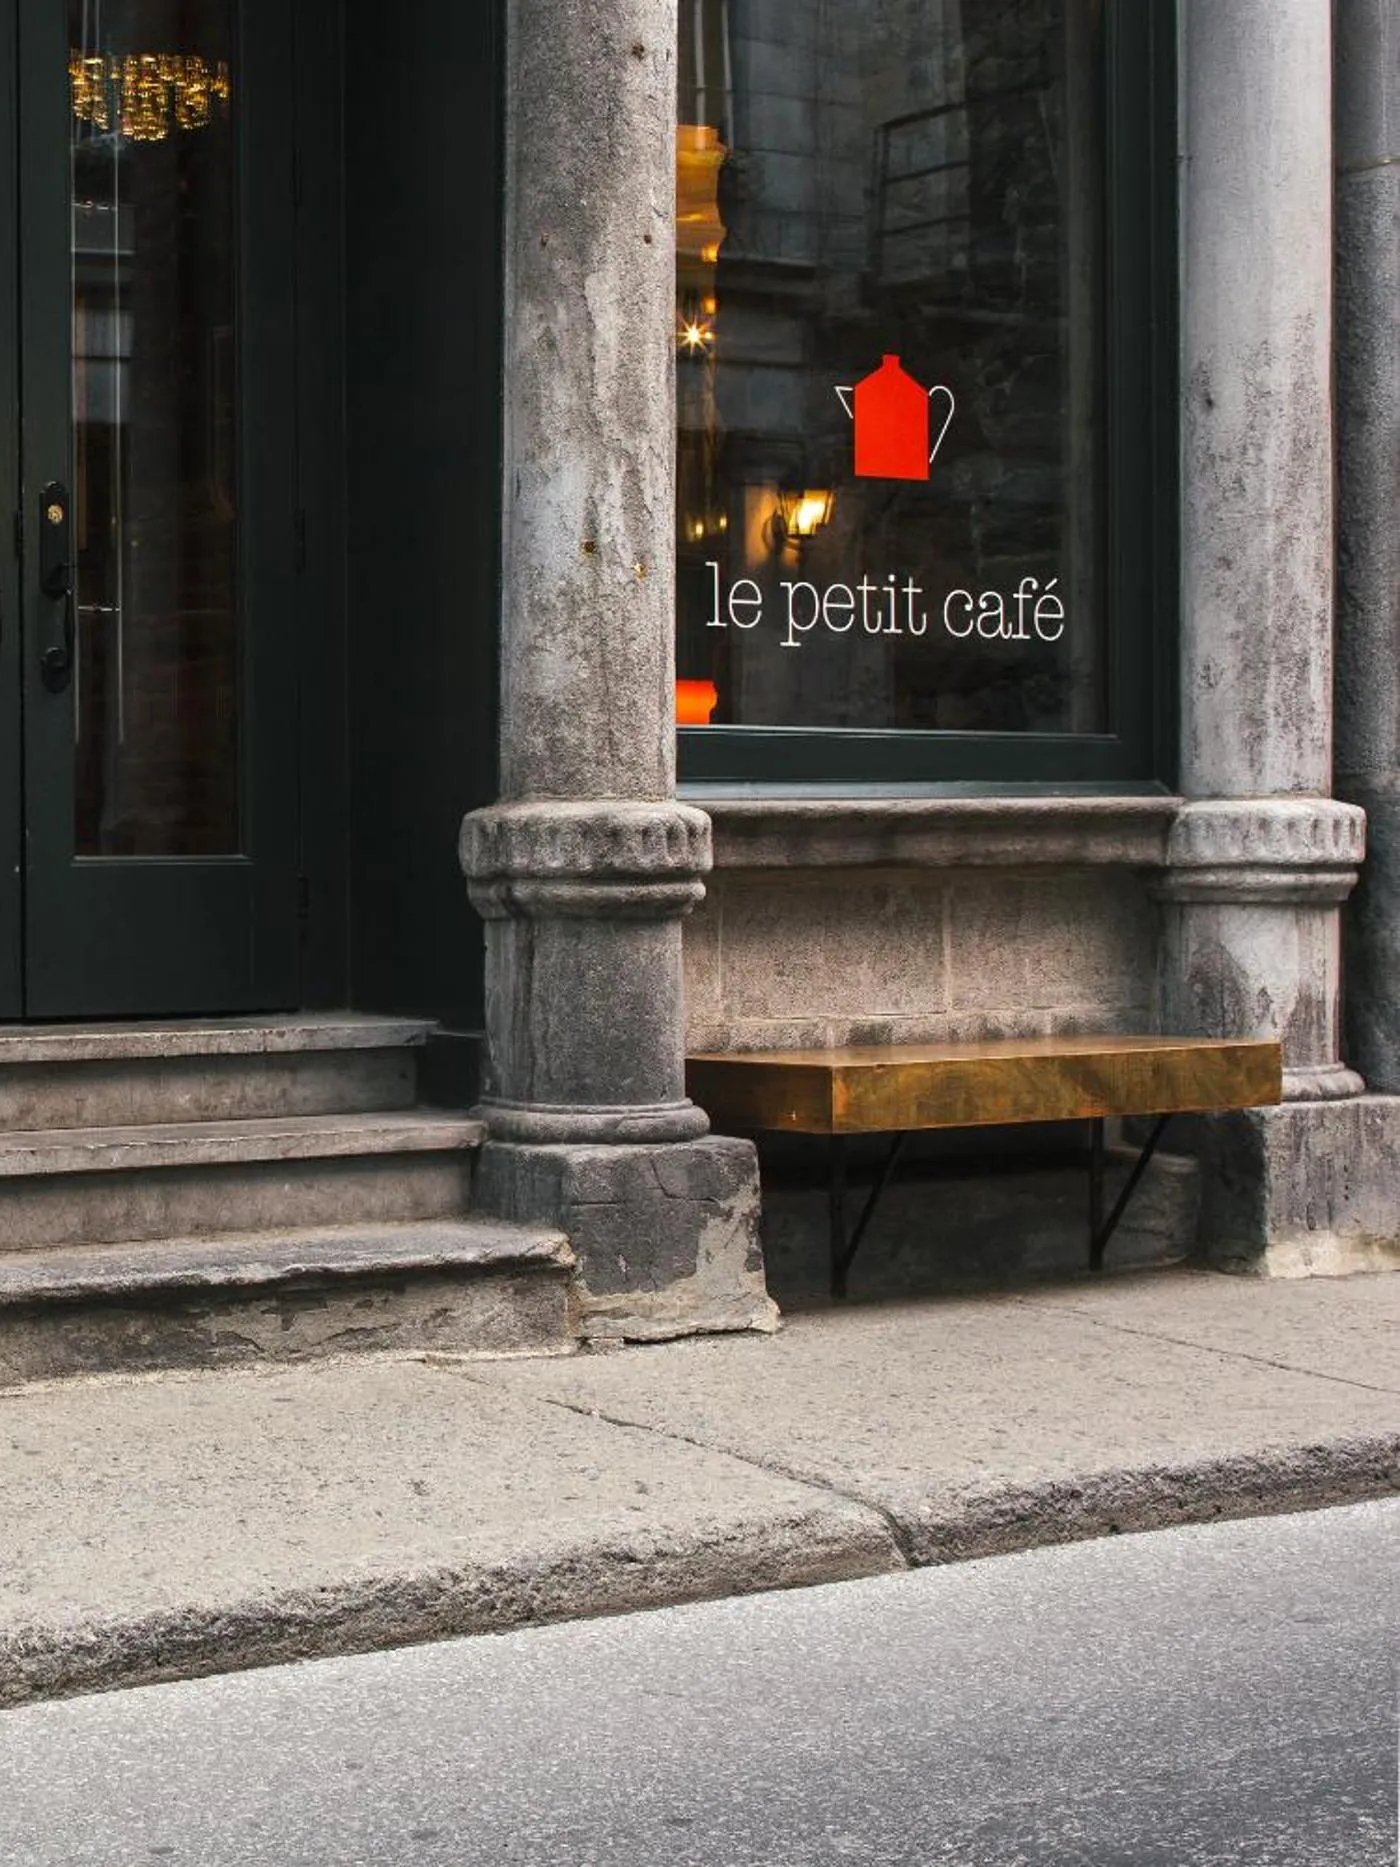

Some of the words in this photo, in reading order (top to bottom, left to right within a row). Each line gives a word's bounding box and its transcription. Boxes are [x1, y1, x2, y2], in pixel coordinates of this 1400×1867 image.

[705, 561, 763, 629] le
[779, 574, 927, 647] petit
[943, 576, 1066, 642] café
